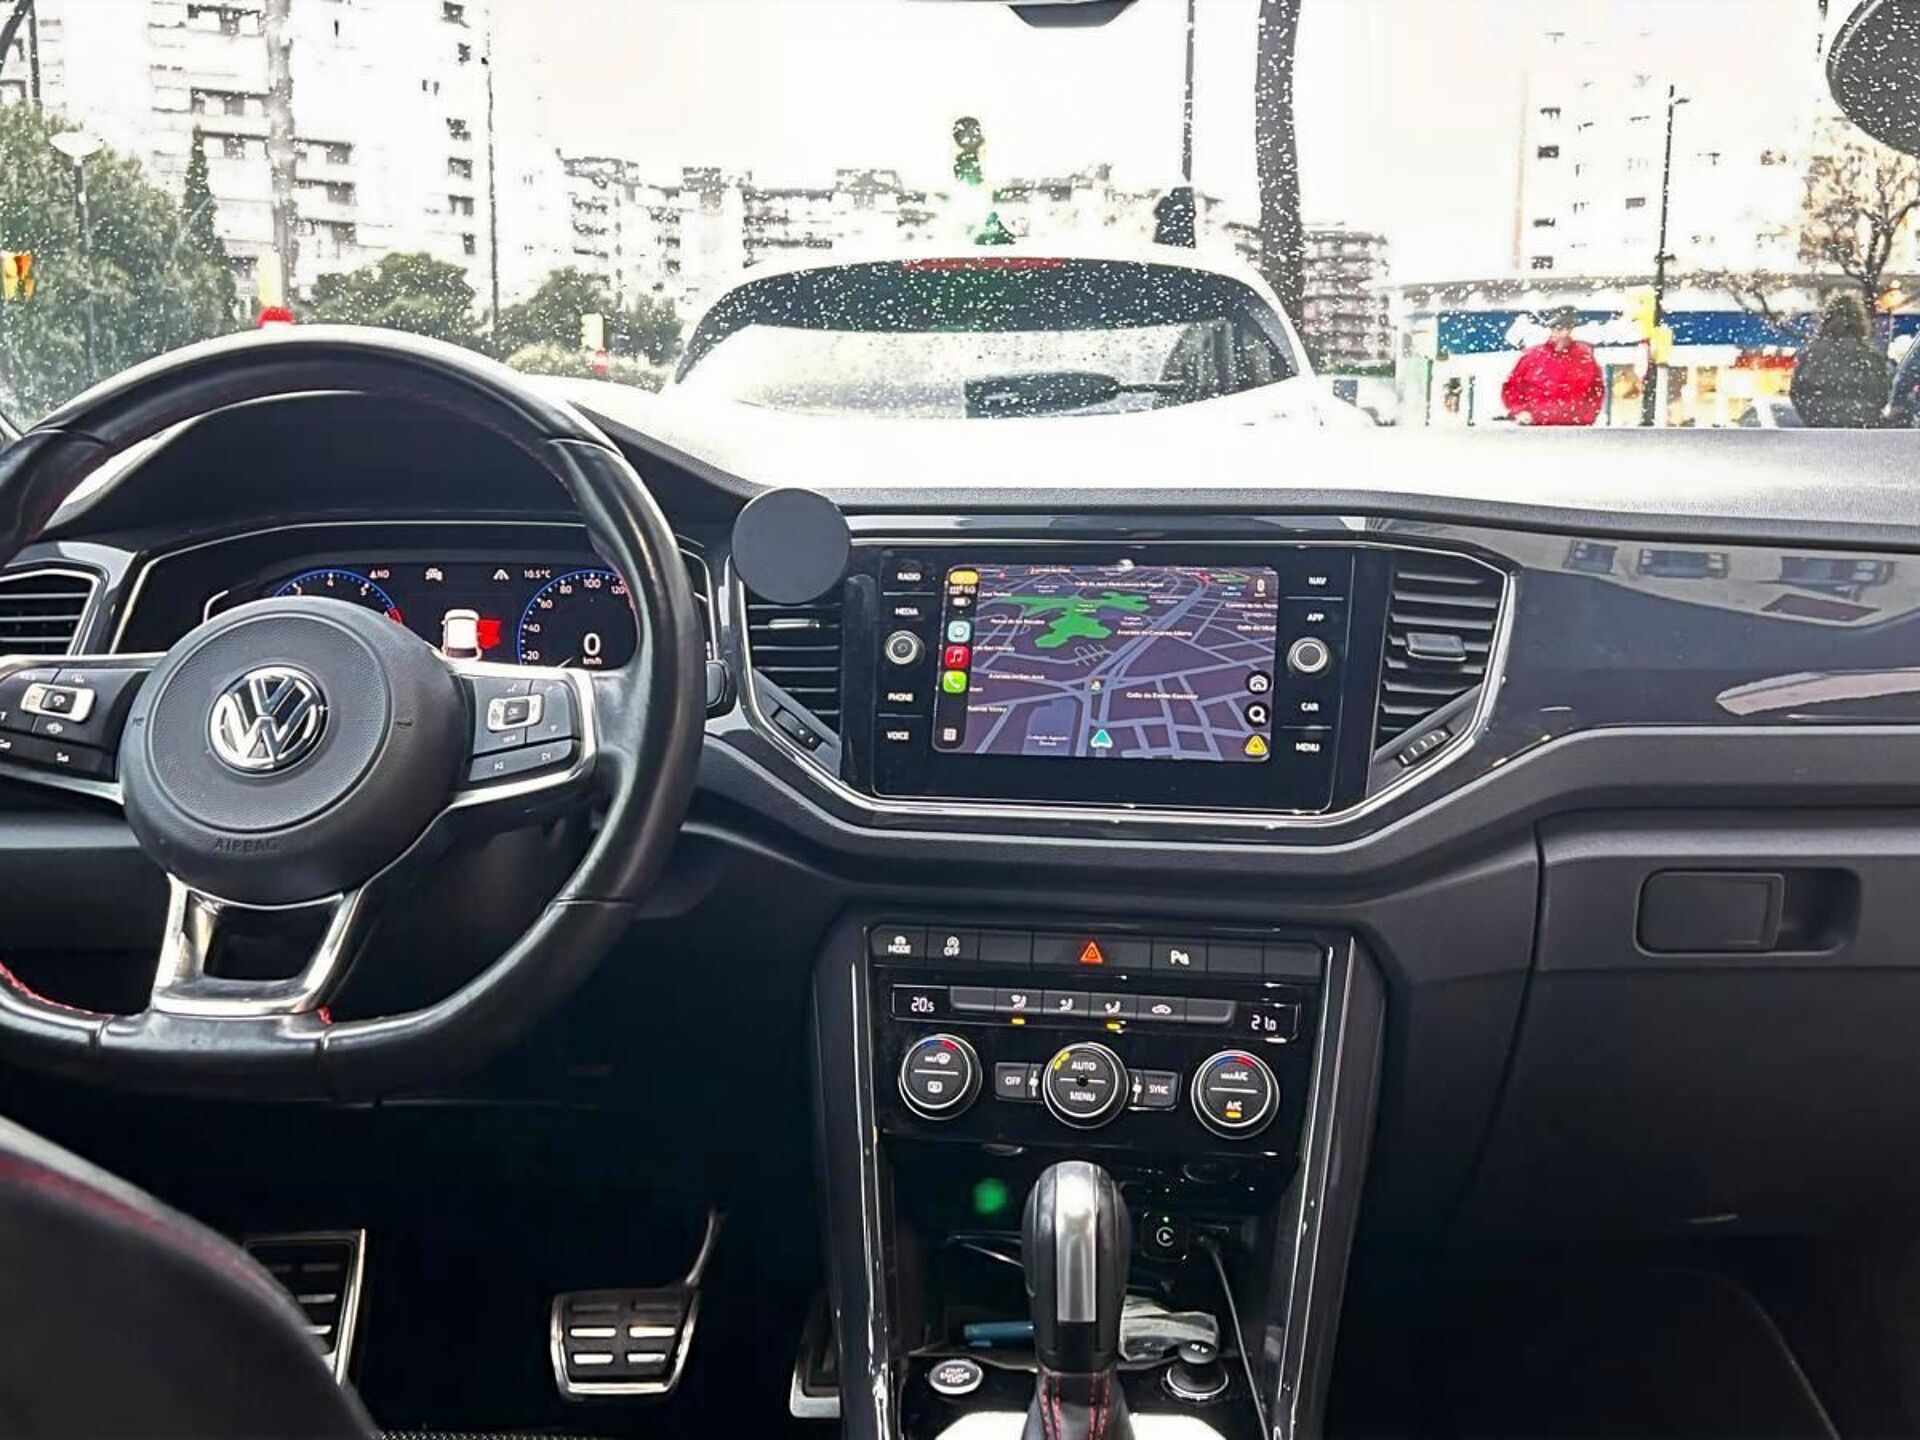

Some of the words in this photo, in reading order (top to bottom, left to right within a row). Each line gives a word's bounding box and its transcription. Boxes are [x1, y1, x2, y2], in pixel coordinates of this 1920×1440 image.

[897, 572, 921, 581] RADIO
[1308, 577, 1327, 585] NAV
[583, 579, 601, 588] 100
[559, 585, 572, 594] 80
[611, 585, 625, 594] 120
[540, 600, 553, 609] 60
[895, 607, 918, 615] MEDIA
[1307, 613, 1324, 622] APP
[528, 623, 540, 632] 40
[583, 633, 601, 656] 0
[527, 651, 539, 660] 20
[887, 693, 913, 701] PHONE
[1301, 702, 1319, 711] CAR
[886, 731, 909, 740] VOICE
[1295, 742, 1320, 752] MENU
[888, 945, 911, 954] MODE
[944, 946, 960, 956] OFF
[1071, 1061, 1097, 1071] AUTO
[1004, 1076, 1021, 1086] OFF
[1149, 1084, 1169, 1095] SYNC
[1070, 1091, 1096, 1102] MENU
[1226, 1100, 1242, 1111] A/C
